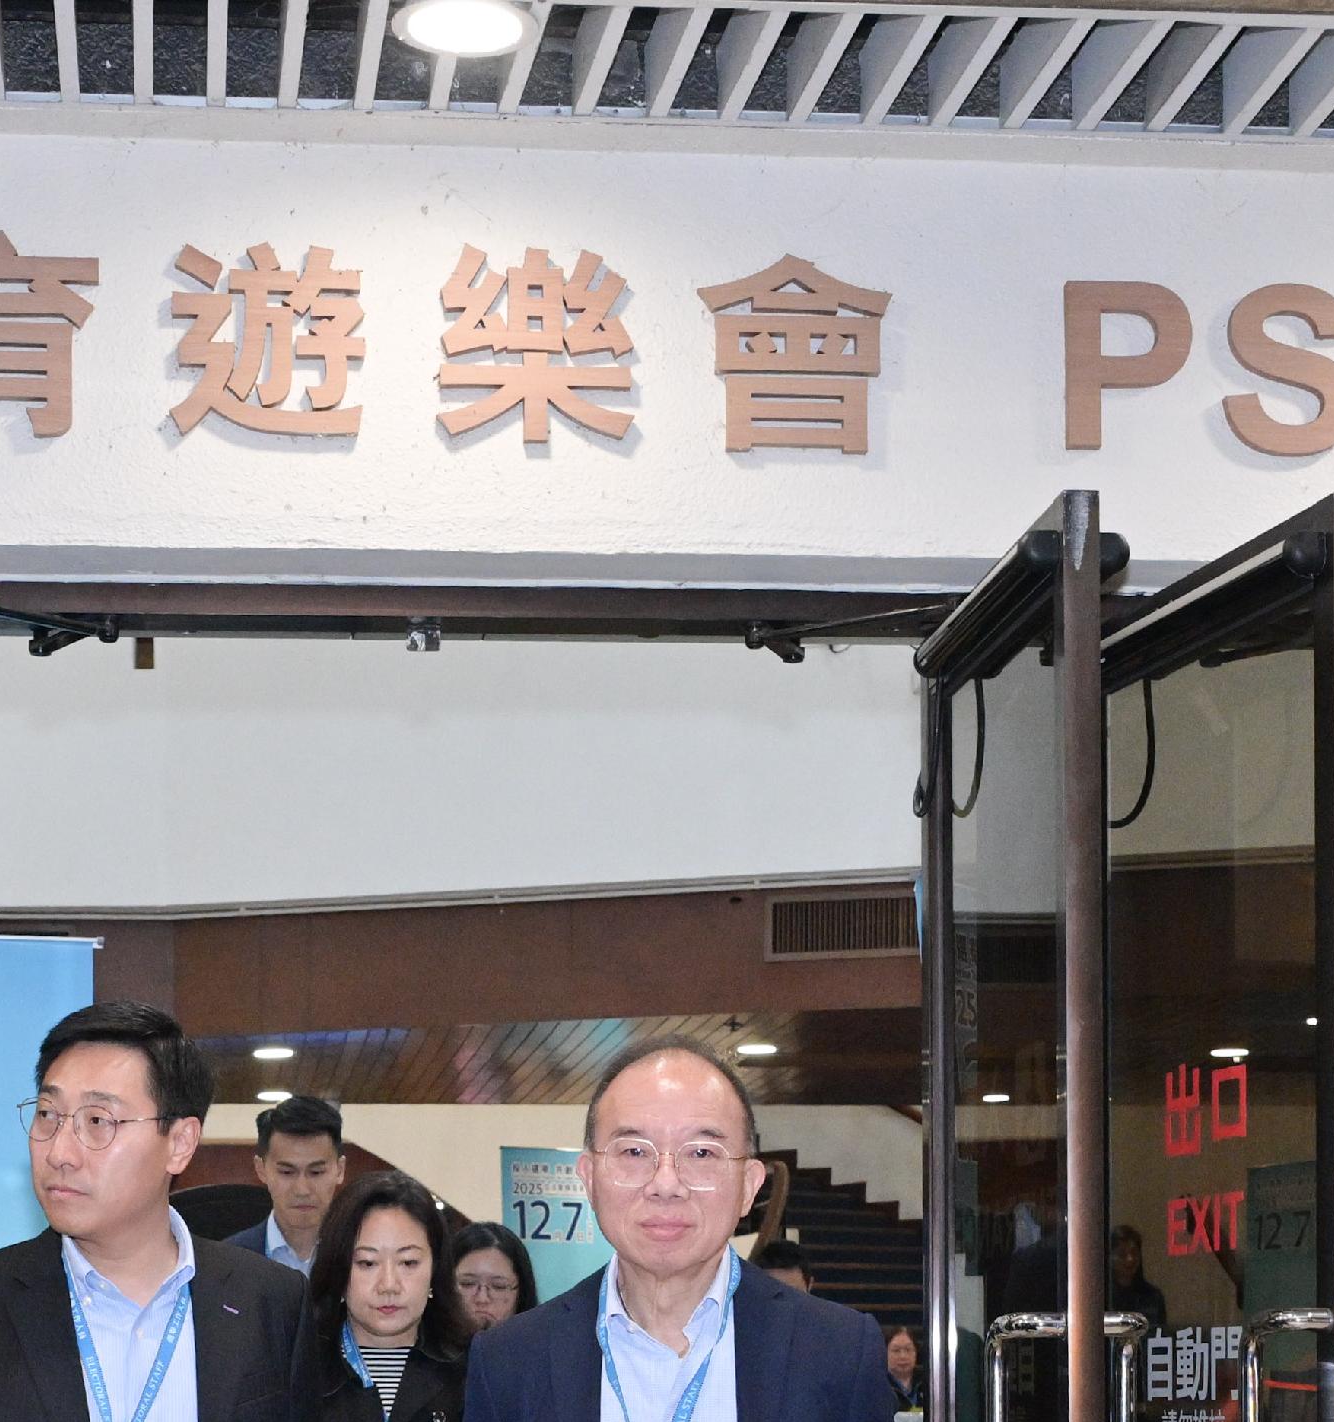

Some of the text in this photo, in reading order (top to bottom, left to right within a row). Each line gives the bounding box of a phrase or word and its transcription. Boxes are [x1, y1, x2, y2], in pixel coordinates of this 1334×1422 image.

[1165, 1062, 1247, 1156] 出口
[513, 1182, 543, 1195] 2025
[1168, 1190, 1245, 1257] EXIT
[1147, 1325, 1243, 1402] 自動門
